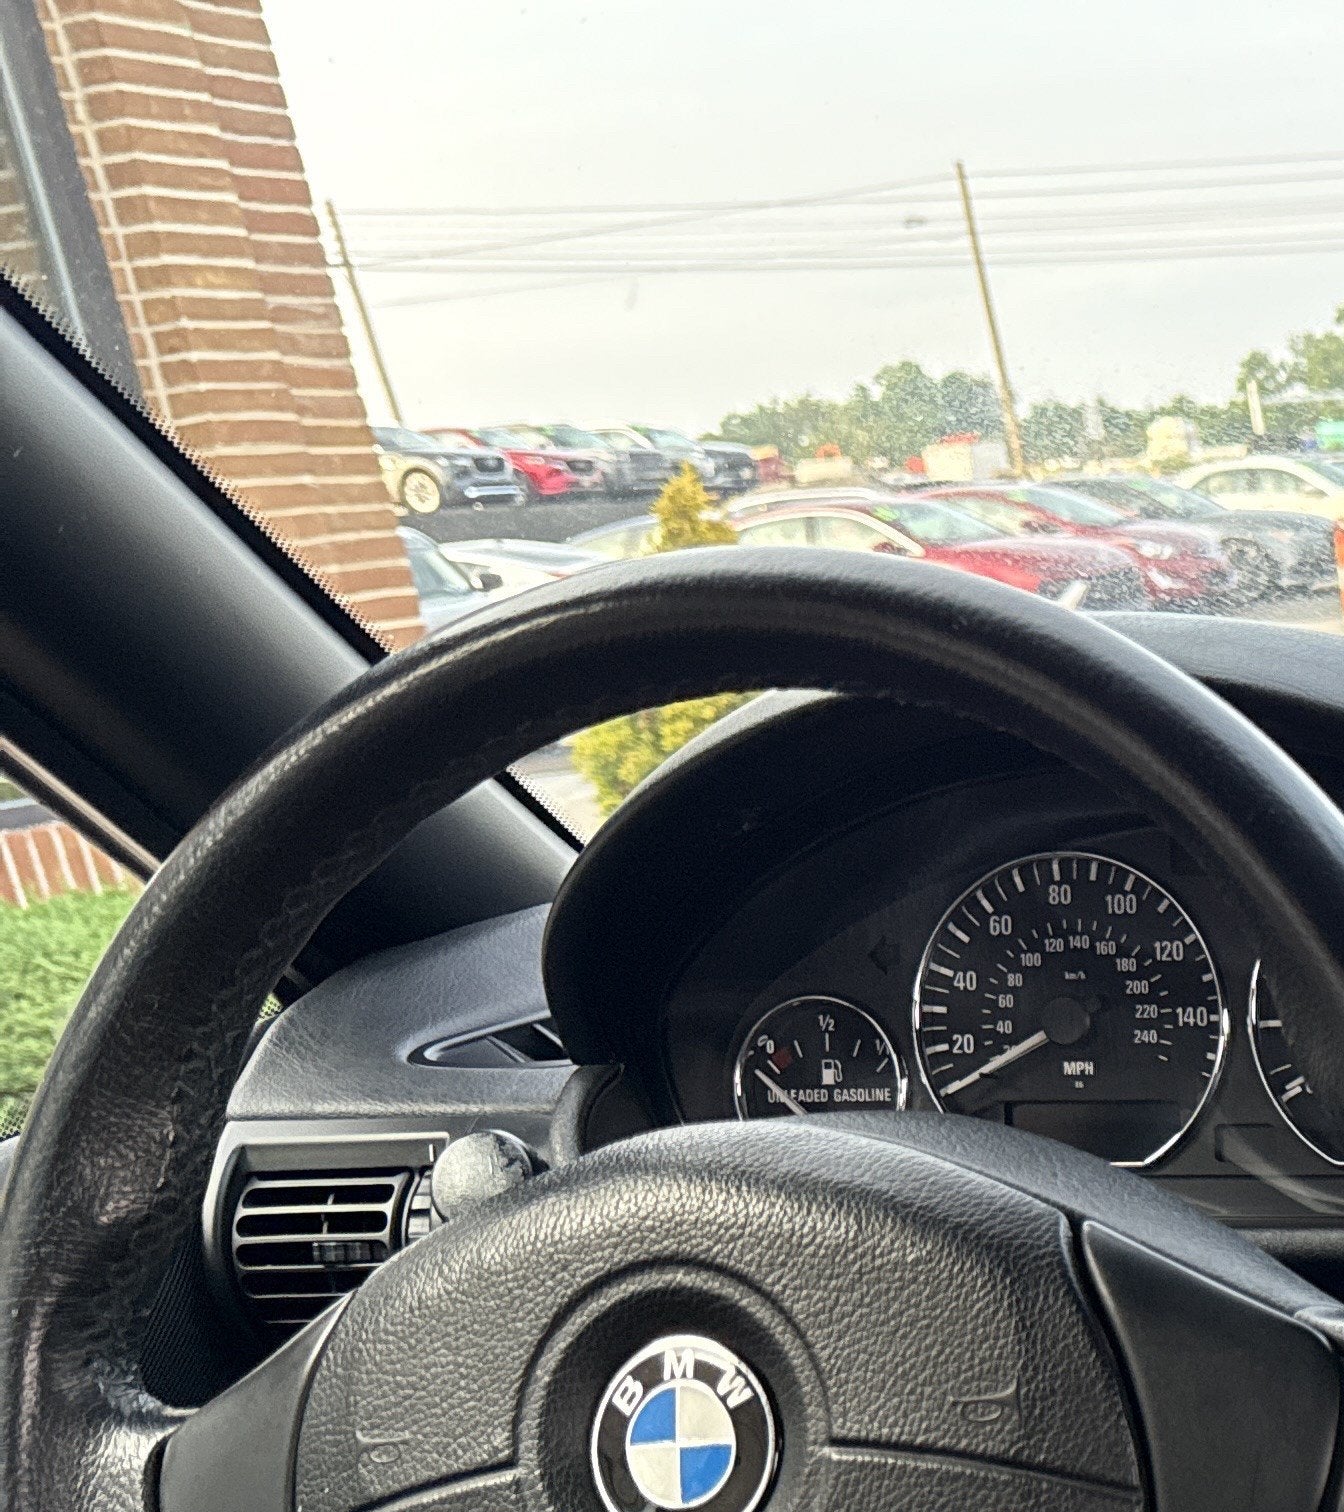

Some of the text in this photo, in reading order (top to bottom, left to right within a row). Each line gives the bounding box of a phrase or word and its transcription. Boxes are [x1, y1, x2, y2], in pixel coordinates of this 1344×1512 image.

[1049, 884, 1071, 905] 80
[1105, 894, 1137, 914] 100
[989, 915, 1012, 935] 60
[1044, 938, 1064, 952] 120
[1069, 935, 1089, 949] 140
[1095, 941, 1116, 955] 160
[1154, 941, 1183, 961] 120
[1020, 952, 1041, 966] 100
[1116, 958, 1136, 972] 180
[953, 970, 976, 991] 40
[1007, 973, 1022, 987] 80
[1065, 971, 1086, 980] km/h
[1126, 980, 1149, 994] 200
[998, 994, 1013, 1008] 60
[1135, 1004, 1157, 1018] 220
[1176, 1006, 1207, 1027] 140
[818, 1014, 834, 1031] 1/2
[996, 1020, 1012, 1034] 40
[952, 1034, 974, 1053] 20
[1134, 1030, 1157, 1044] 240
[1063, 1061, 1094, 1075] MPH
[833, 1087, 892, 1102] GASOLINE
[611, 1348, 754, 1416] BMW
